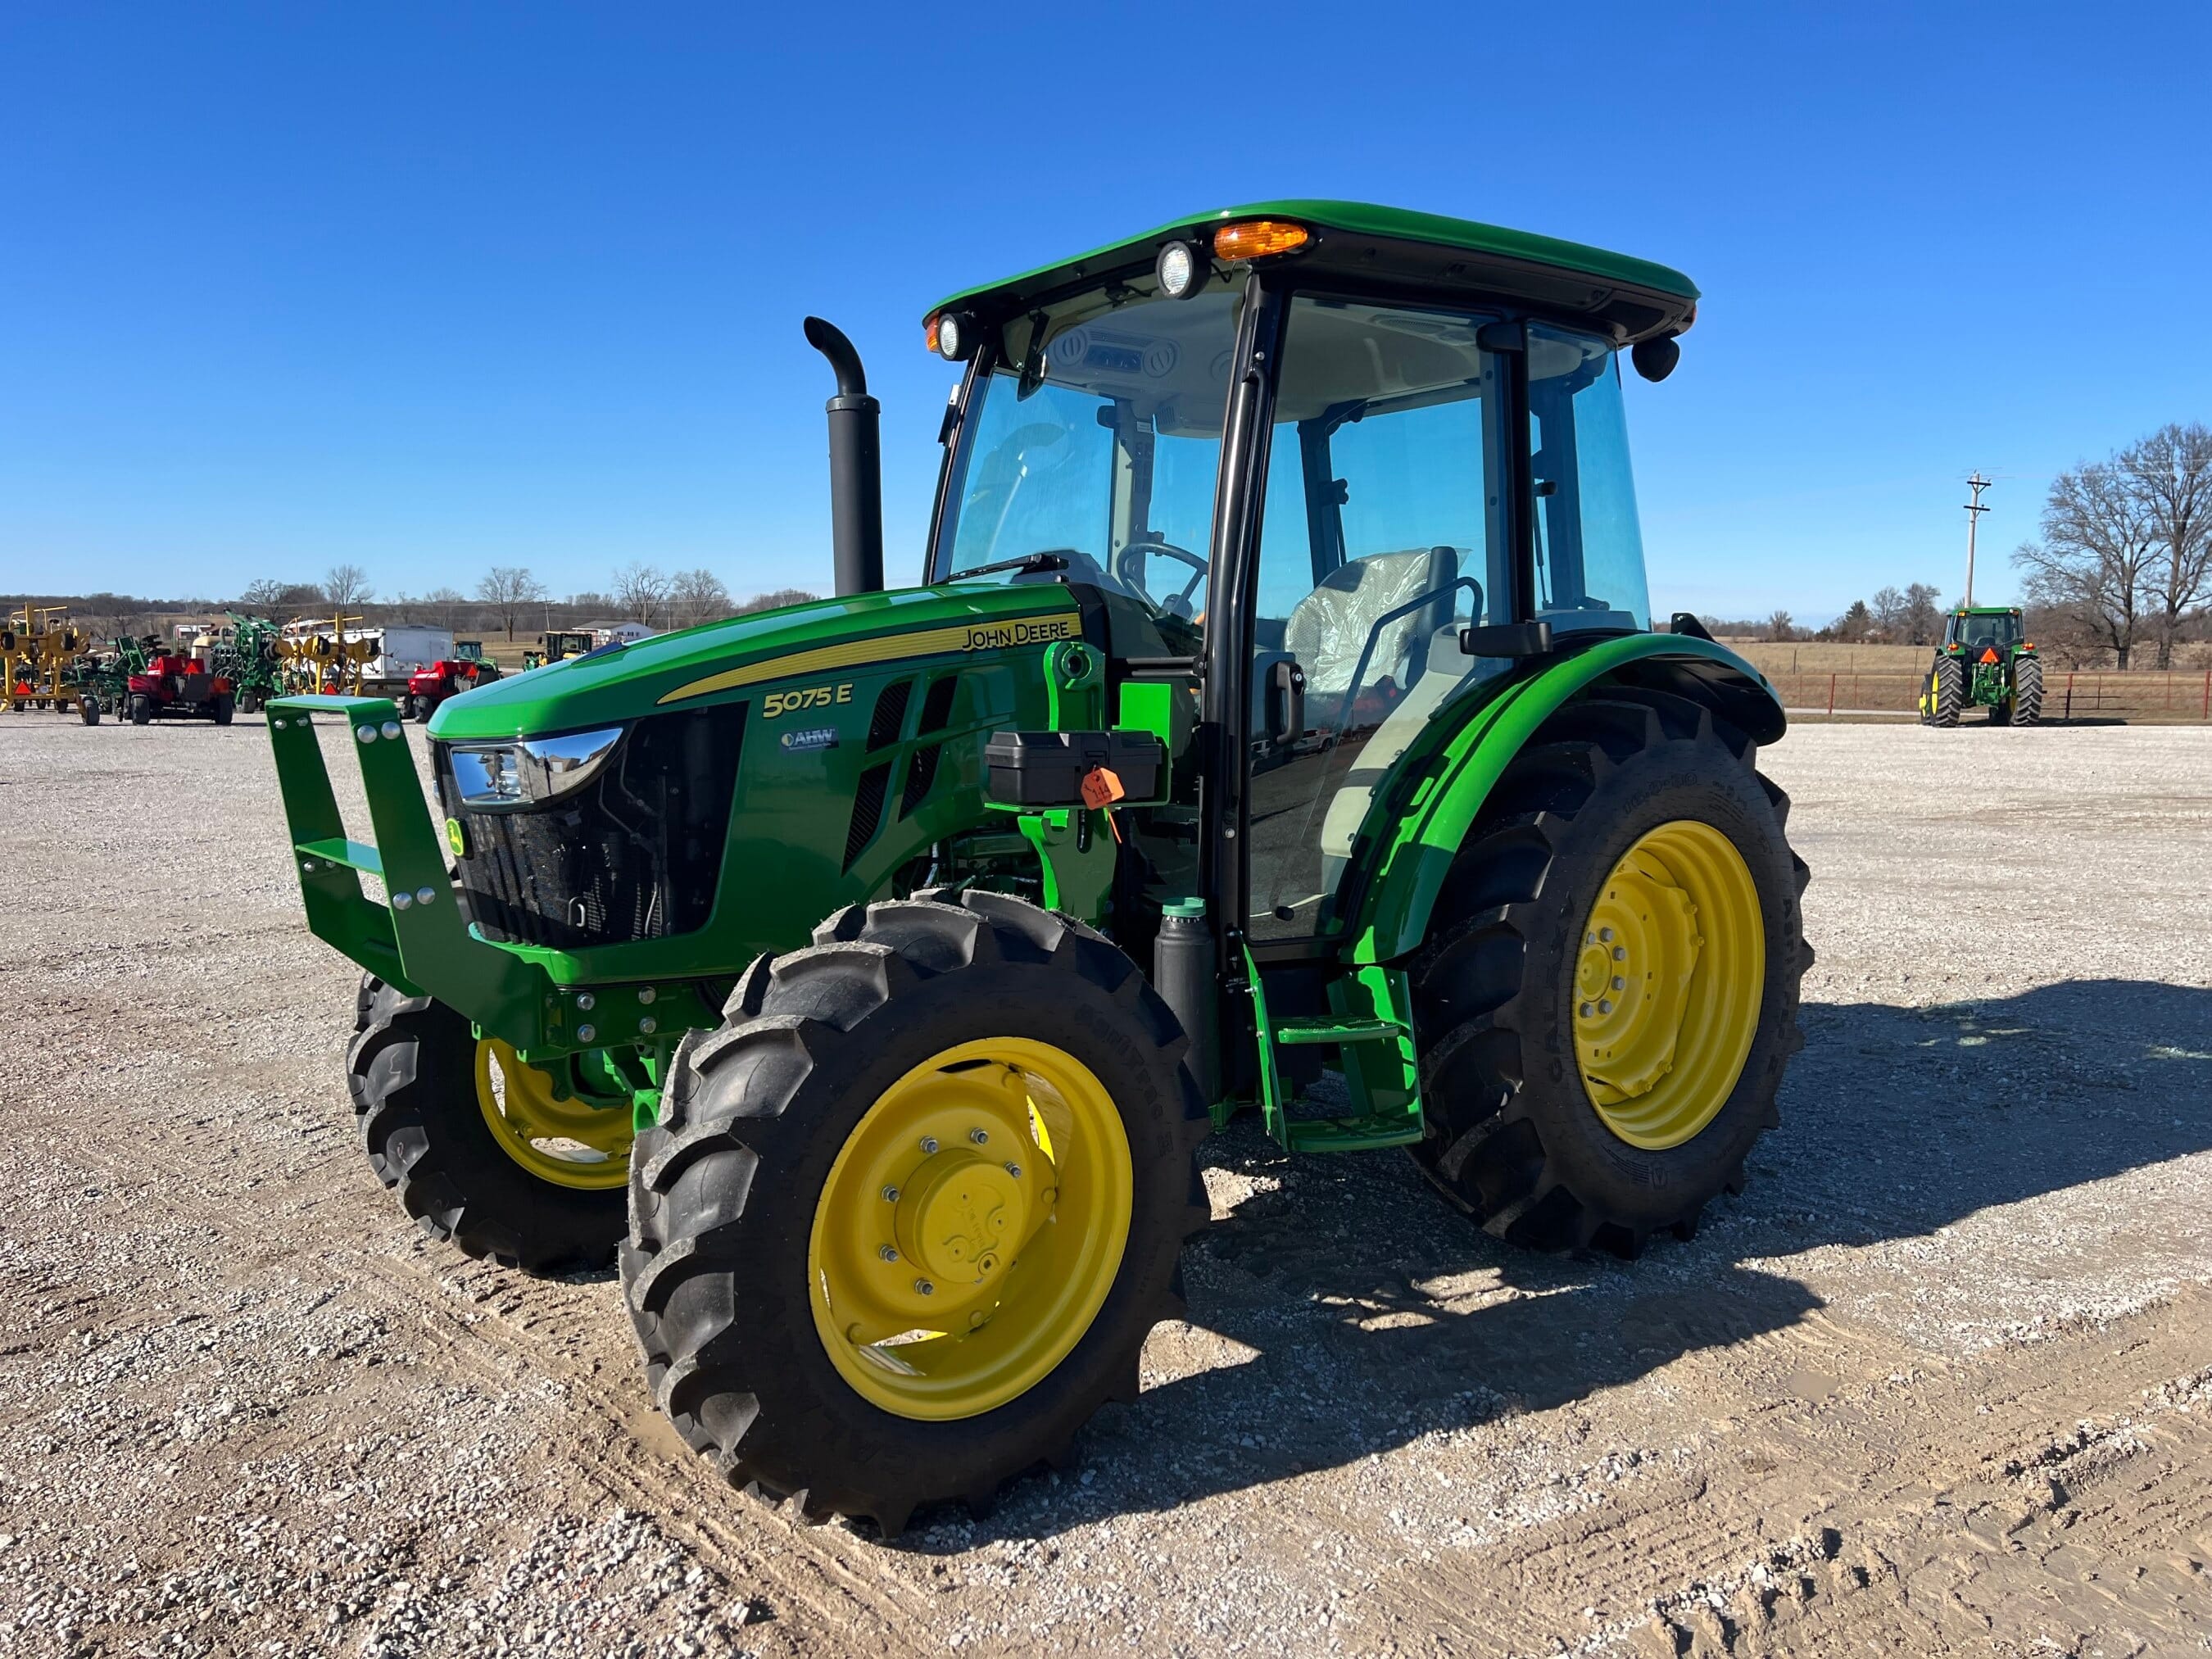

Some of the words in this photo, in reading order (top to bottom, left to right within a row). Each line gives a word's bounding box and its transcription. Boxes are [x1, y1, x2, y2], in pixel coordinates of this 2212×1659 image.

[962, 628, 1012, 649] JOHN
[1015, 621, 1070, 642] DEERE
[763, 687, 832, 718] 5075
[836, 683, 854, 703] E
[794, 728, 832, 746] AHW
